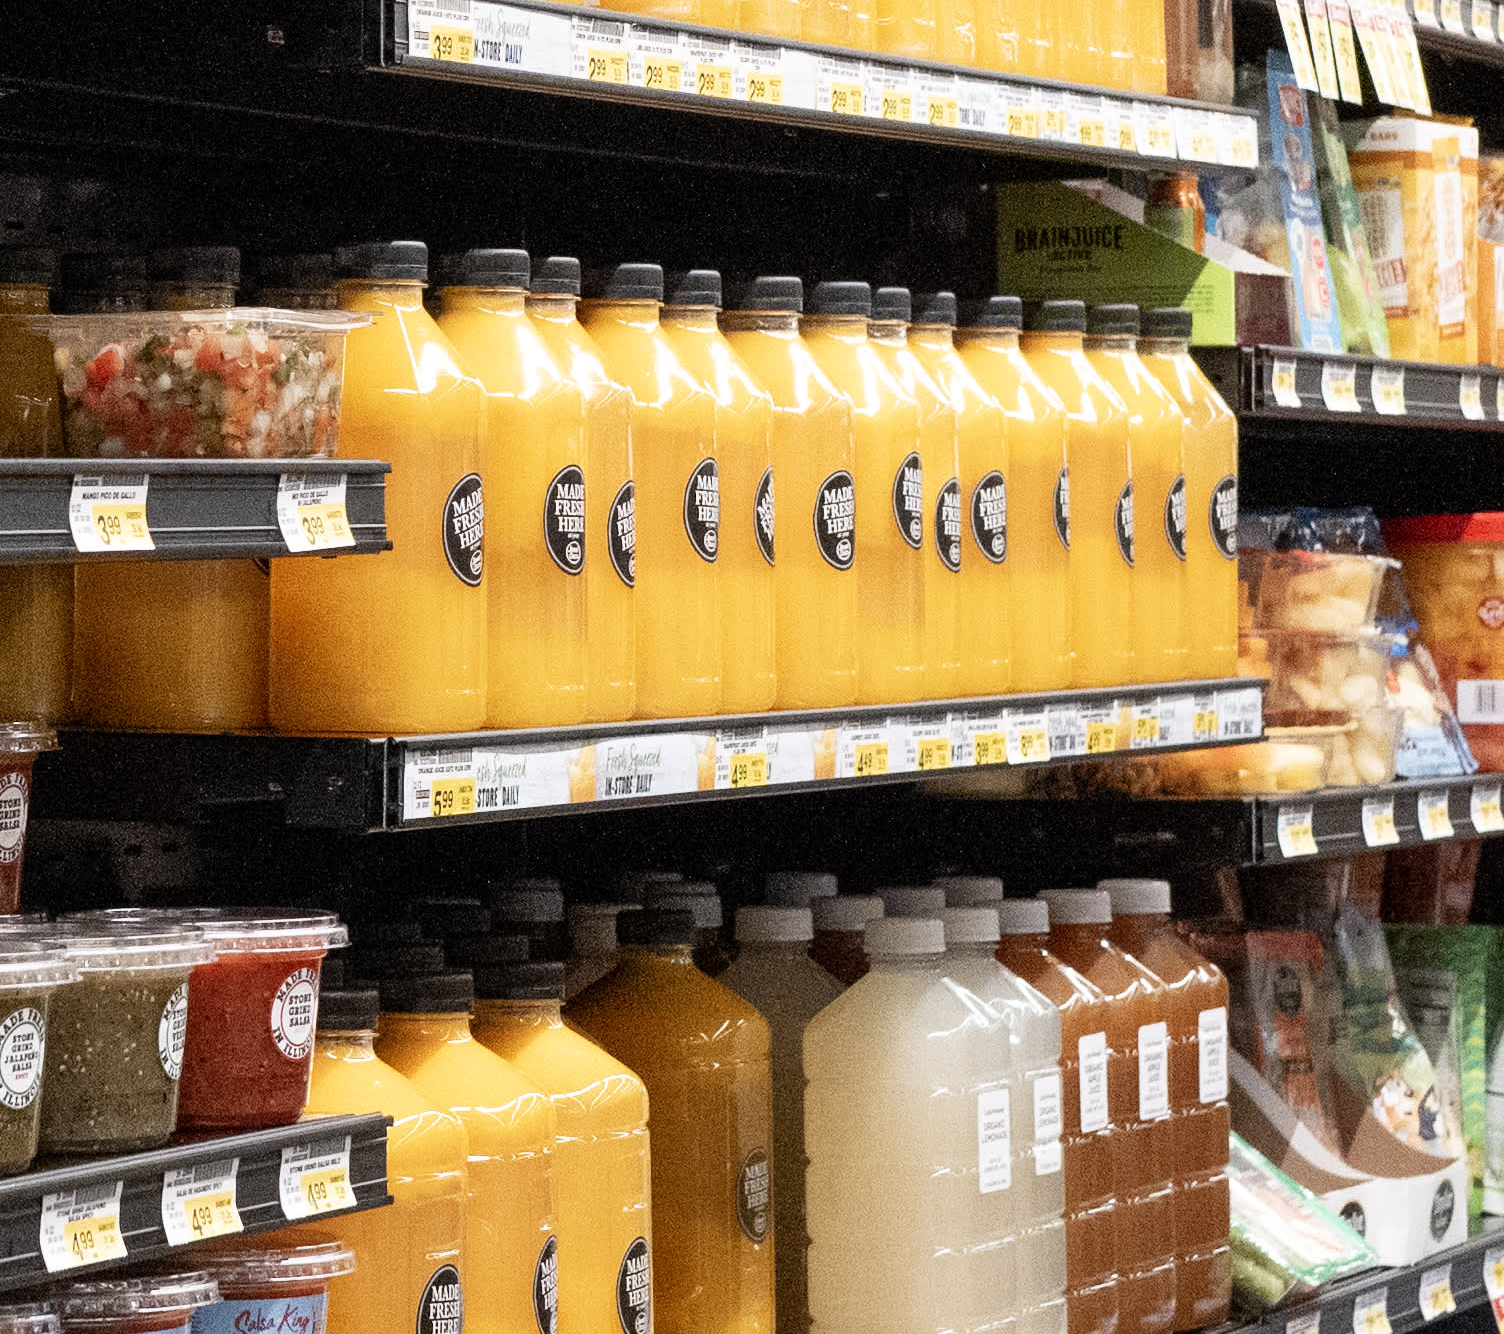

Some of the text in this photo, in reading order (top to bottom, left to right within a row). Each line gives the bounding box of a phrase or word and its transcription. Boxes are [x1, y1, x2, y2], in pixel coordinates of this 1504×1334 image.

[505, 43, 524, 66] DAILY
[1014, 223, 1125, 253] BRAINJUICE
[556, 483, 585, 499] MADE
[823, 487, 854, 505] MADE
[636, 773, 653, 794] DAILY
[431, 1284, 460, 1302] MADE
